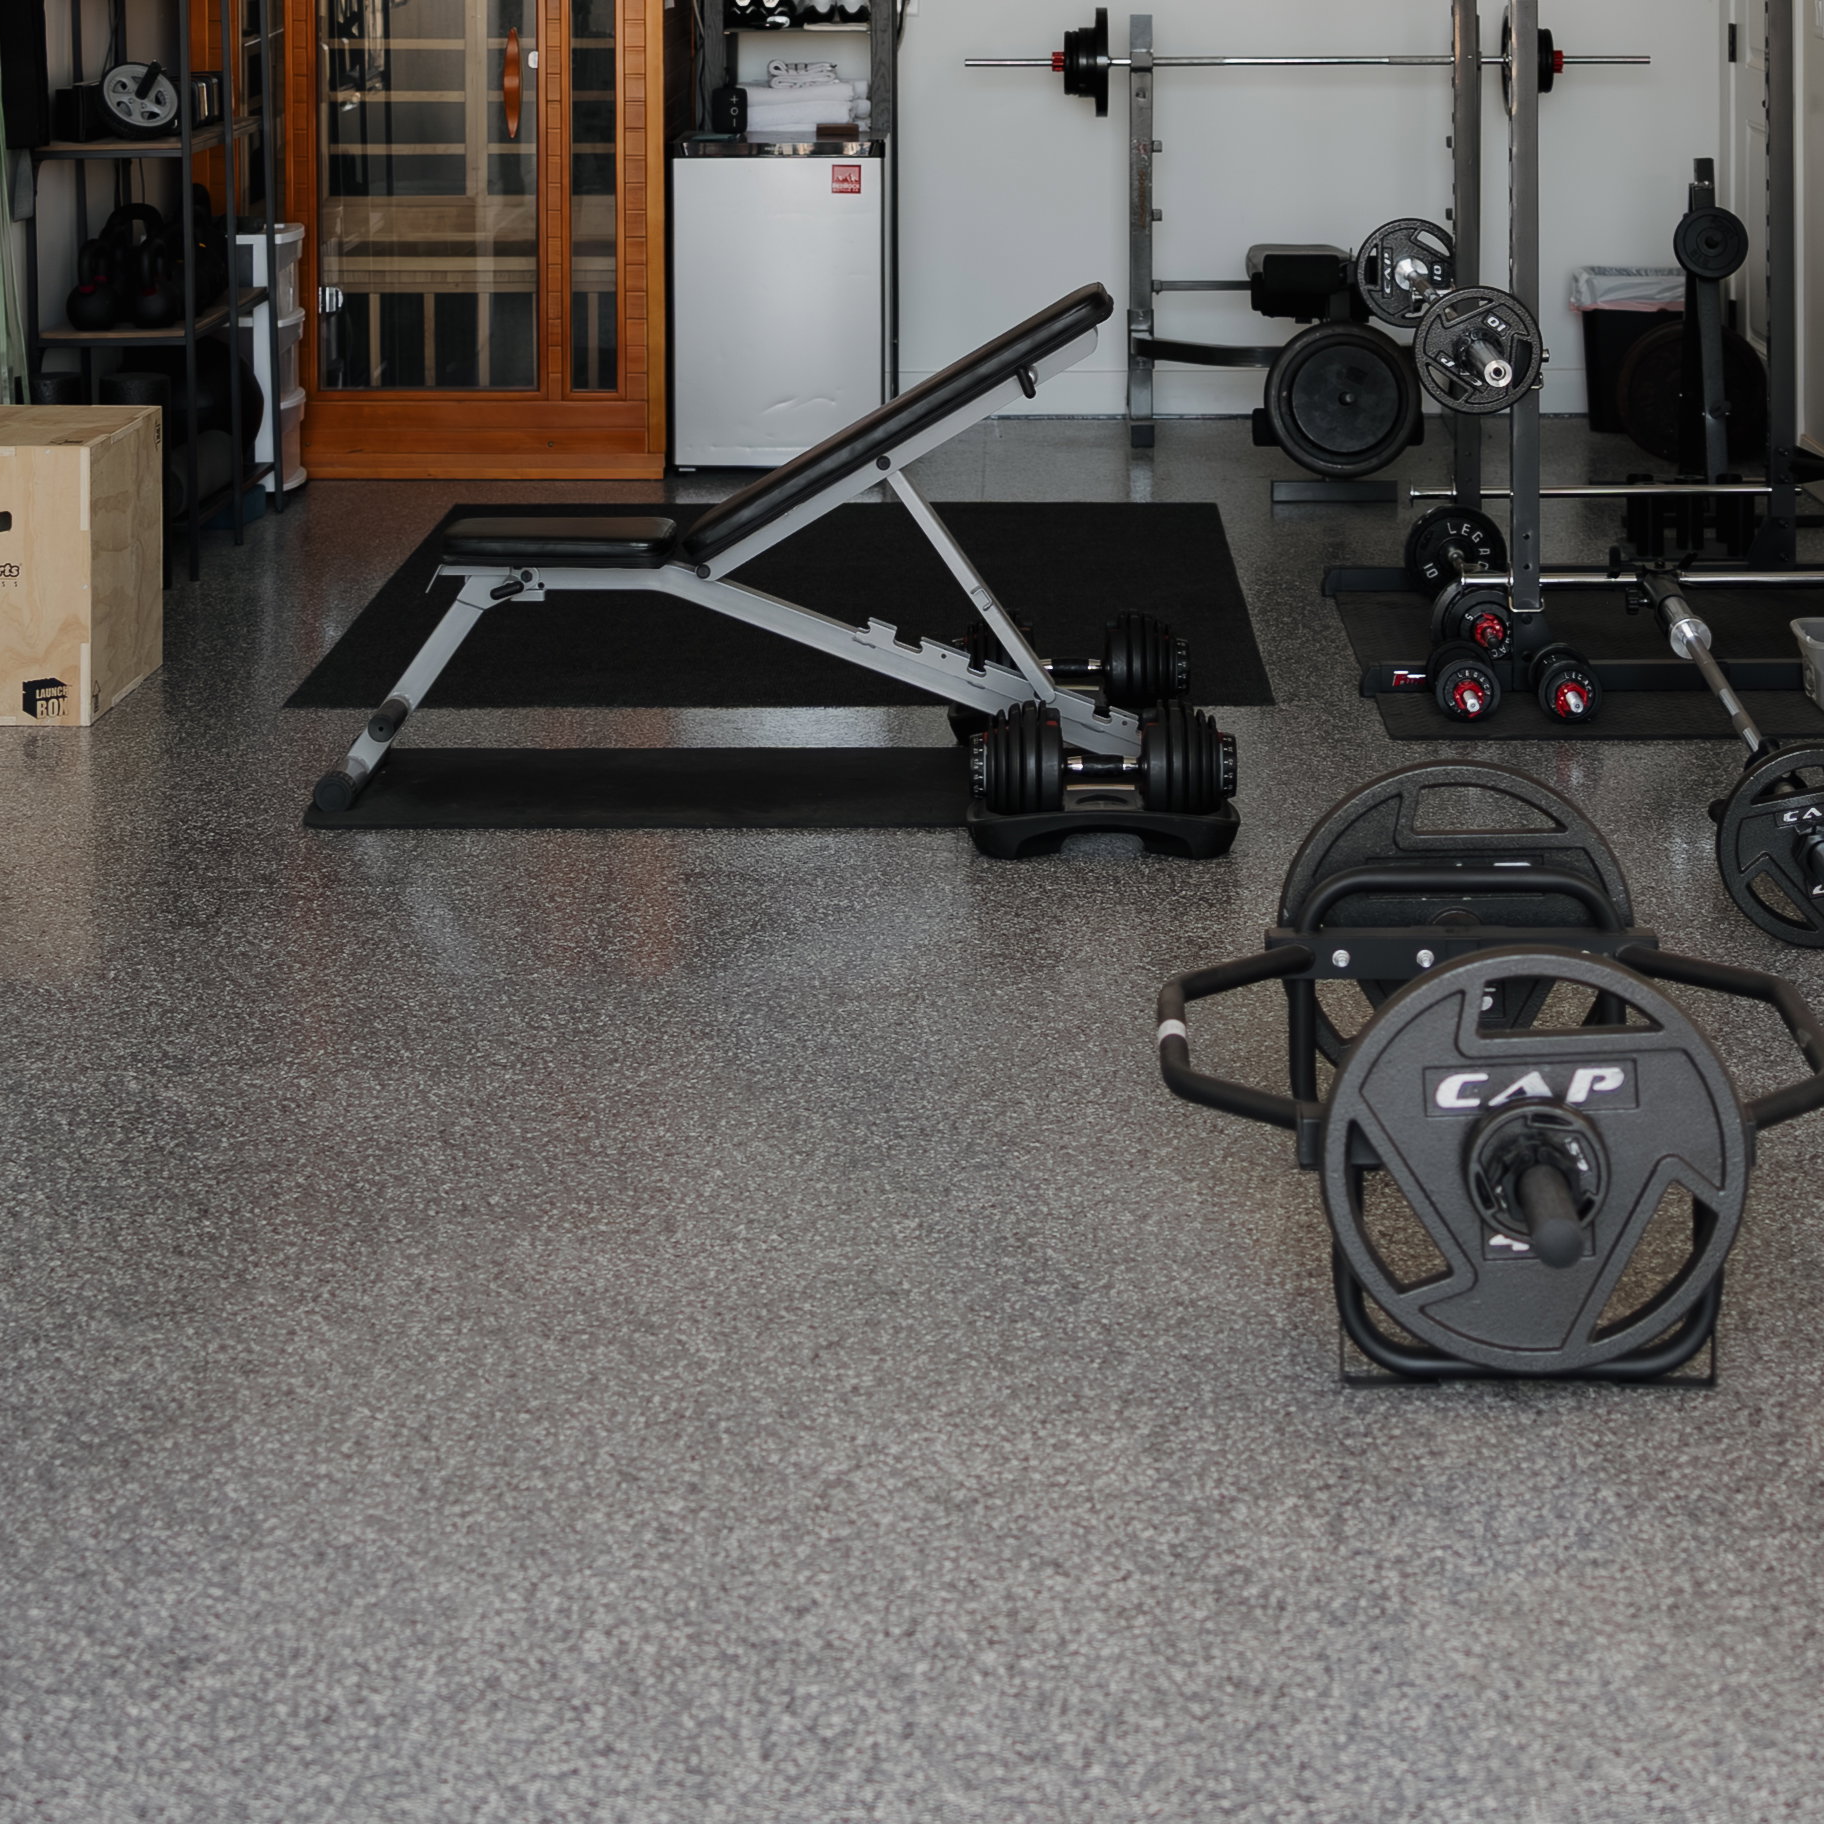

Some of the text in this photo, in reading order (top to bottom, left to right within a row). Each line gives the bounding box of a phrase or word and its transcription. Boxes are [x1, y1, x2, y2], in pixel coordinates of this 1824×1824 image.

[1383, 252, 1392, 294] CAP
[1433, 265, 1442, 281] 10
[1487, 316, 1506, 332] 10
[1447, 522, 1491, 571] LEGAC
[1423, 562, 1439, 579] 10
[36, 686, 69, 699] LAUNCH
[36, 697, 69, 719] BOX
[1435, 1067, 1626, 1109] CAP
